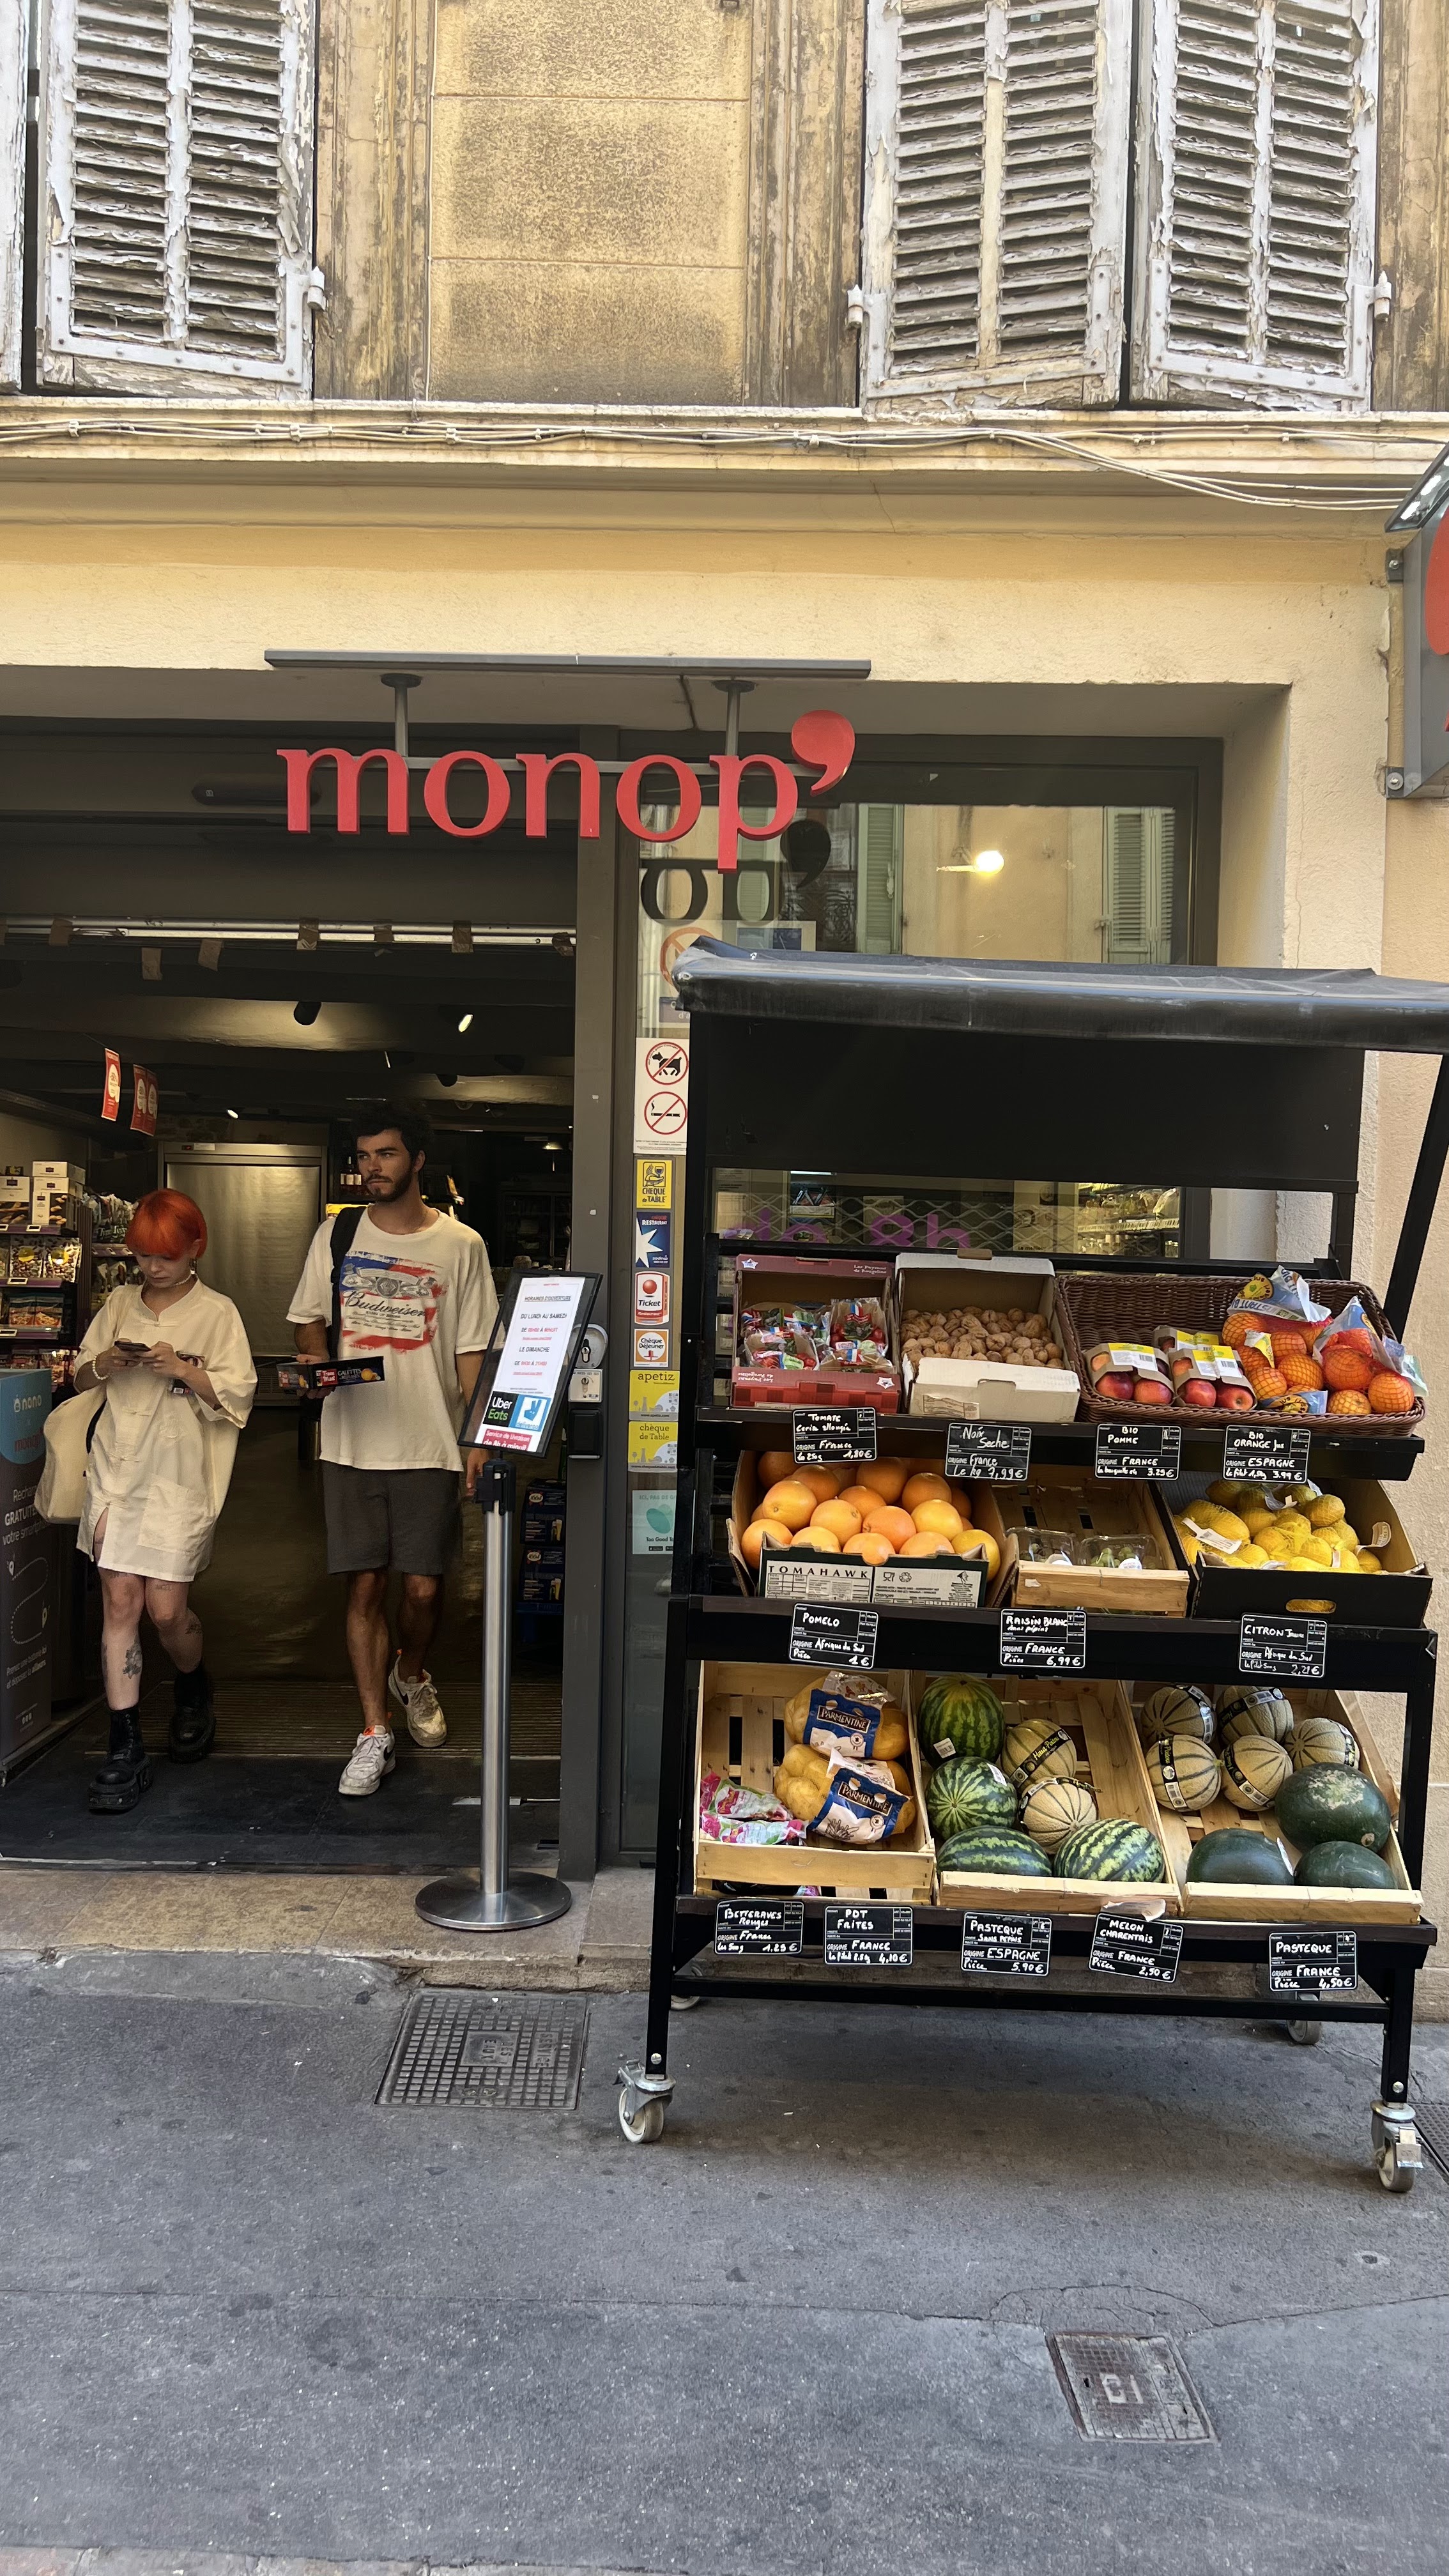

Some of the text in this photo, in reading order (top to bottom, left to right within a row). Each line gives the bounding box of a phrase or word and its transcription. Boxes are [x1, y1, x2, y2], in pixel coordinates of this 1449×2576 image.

[277, 709, 855, 873] monop'
[342, 1290, 425, 1316] Budweiser
[638, 1372, 675, 1383] apetiz
[493, 1397, 512, 1409] Uber
[487, 1409, 509, 1421] Eats
[640, 1423, 670, 1433] chèque
[1108, 1434, 1138, 1444] POMME
[1248, 1431, 1264, 1439] BIO
[1234, 1439, 1271, 1448] ORANGE
[1122, 1457, 1158, 1466] FRANCE
[1248, 1458, 1295, 1468] ESPAGNE
[3, 1530, 20, 1545] votre
[769, 1565, 868, 1579] TOMAHAWK
[802, 1612, 839, 1627] POMELO
[1244, 1625, 1284, 1637] CITRON
[815, 1637, 841, 1650] Afrique
[853, 1643, 865, 1653] Sud
[1025, 1643, 1065, 1653] FRANCE
[821, 1708, 866, 1729] PARMENTINE
[842, 1786, 889, 1811] PARMENTINE
[724, 1908, 781, 1919] BETTERAVES
[845, 1909, 868, 1918] PDT
[838, 1919, 873, 1929] FRITES
[970, 1920, 1023, 1935] PASTEQUE
[1109, 1920, 1144, 1932] MELON
[1100, 1929, 1153, 1943] CHARENTAIS
[852, 1940, 891, 1951] FRANCE
[1276, 1942, 1332, 1954] PASTEQUE
[987, 1947, 1041, 1961] ESPAGNE
[1093, 1950, 1155, 1966] ORIGINE FRANCE
[1296, 1965, 1340, 1977] FRANCE
